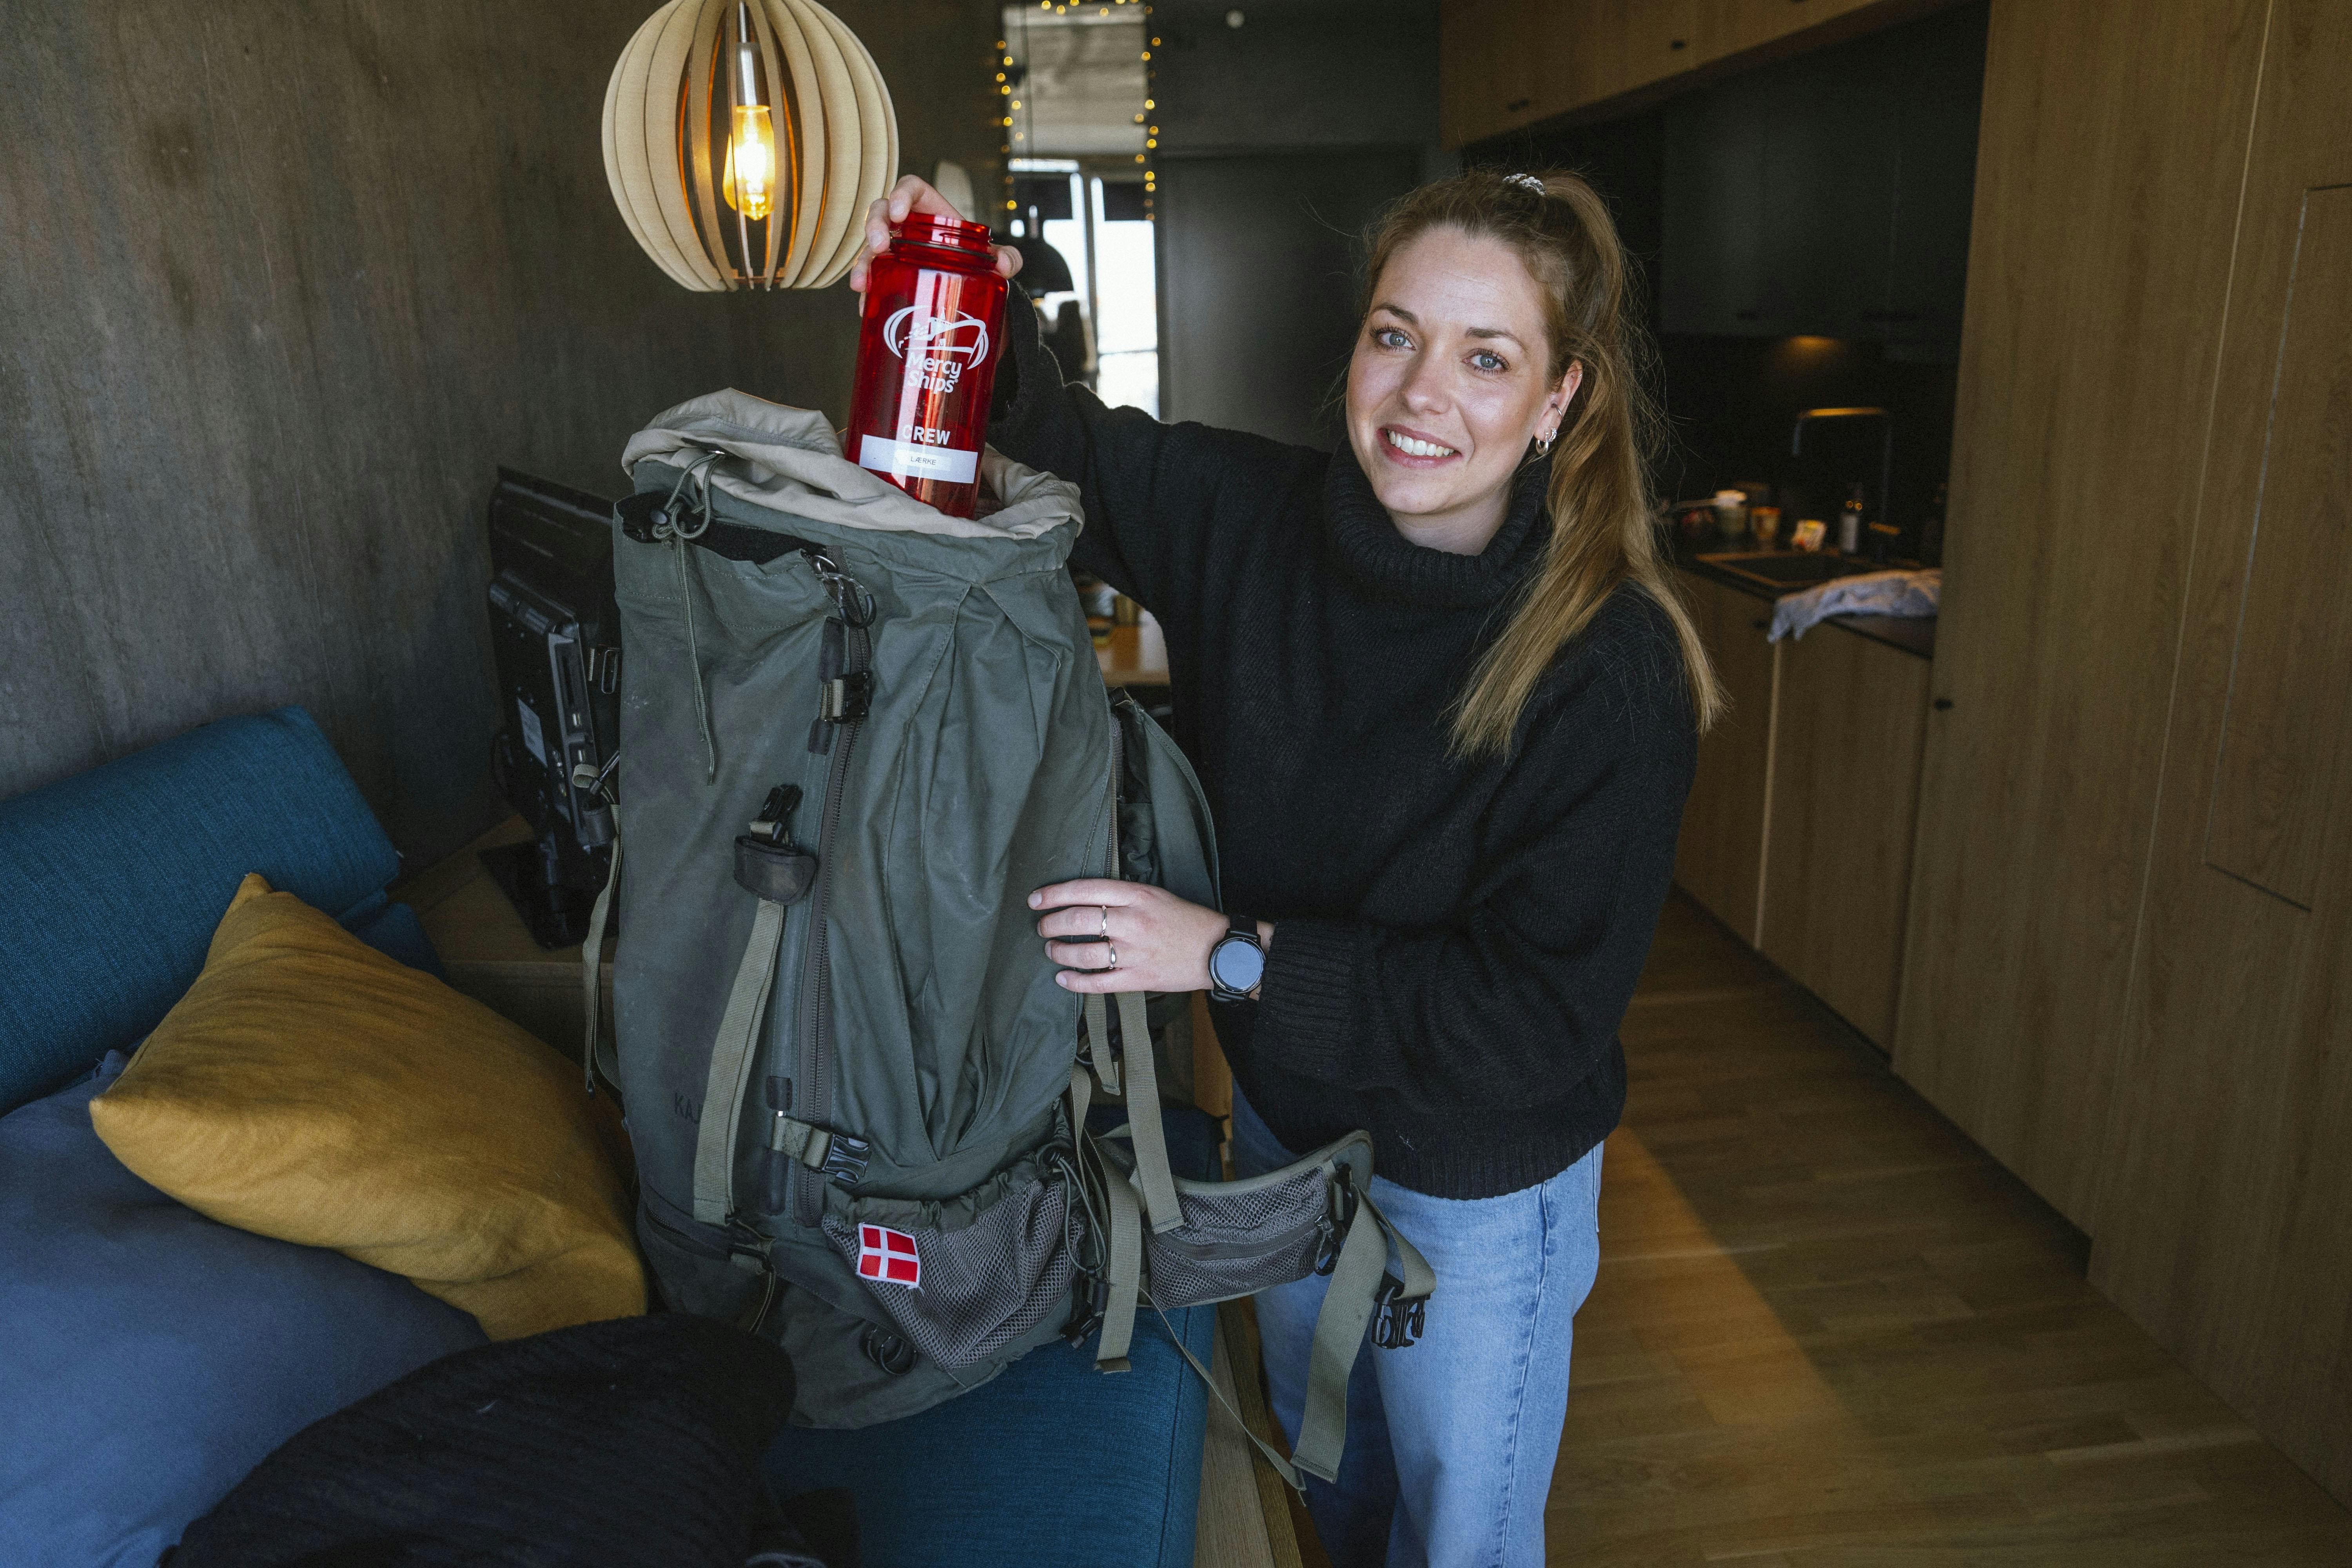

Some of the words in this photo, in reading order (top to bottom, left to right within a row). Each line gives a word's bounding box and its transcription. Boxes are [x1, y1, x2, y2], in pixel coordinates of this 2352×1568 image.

[906, 352, 962, 379] Mercy
[902, 425, 951, 445] CREW
[910, 456, 936, 465] LÆRKE
[675, 1092, 703, 1124] KAJ
